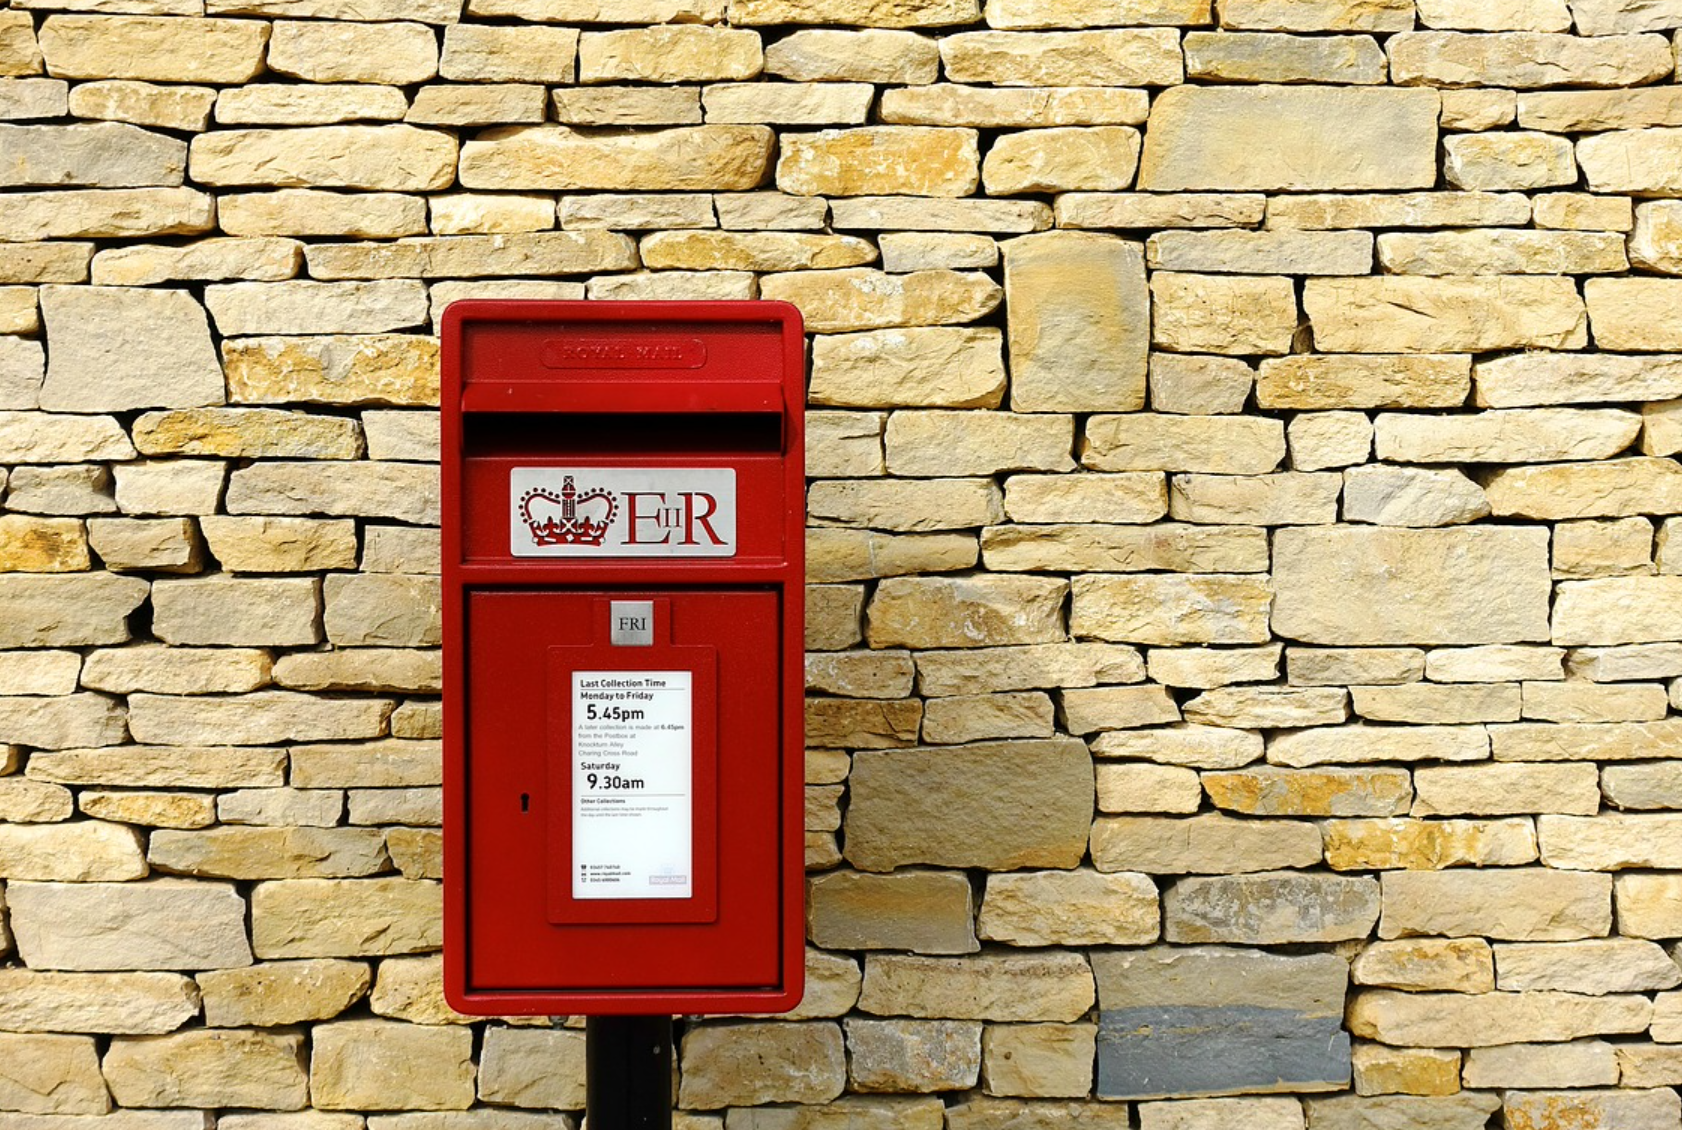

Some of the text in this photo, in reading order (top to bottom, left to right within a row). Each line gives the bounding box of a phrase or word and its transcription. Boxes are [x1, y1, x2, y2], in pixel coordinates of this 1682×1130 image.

[618, 617, 647, 631] FRI
[580, 679, 667, 688] Last Collection Time
[580, 691, 654, 701] Monday to Friday
[587, 703, 645, 722] 5.45pm
[580, 761, 621, 771] Saturday
[587, 773, 645, 789] 9.30am
